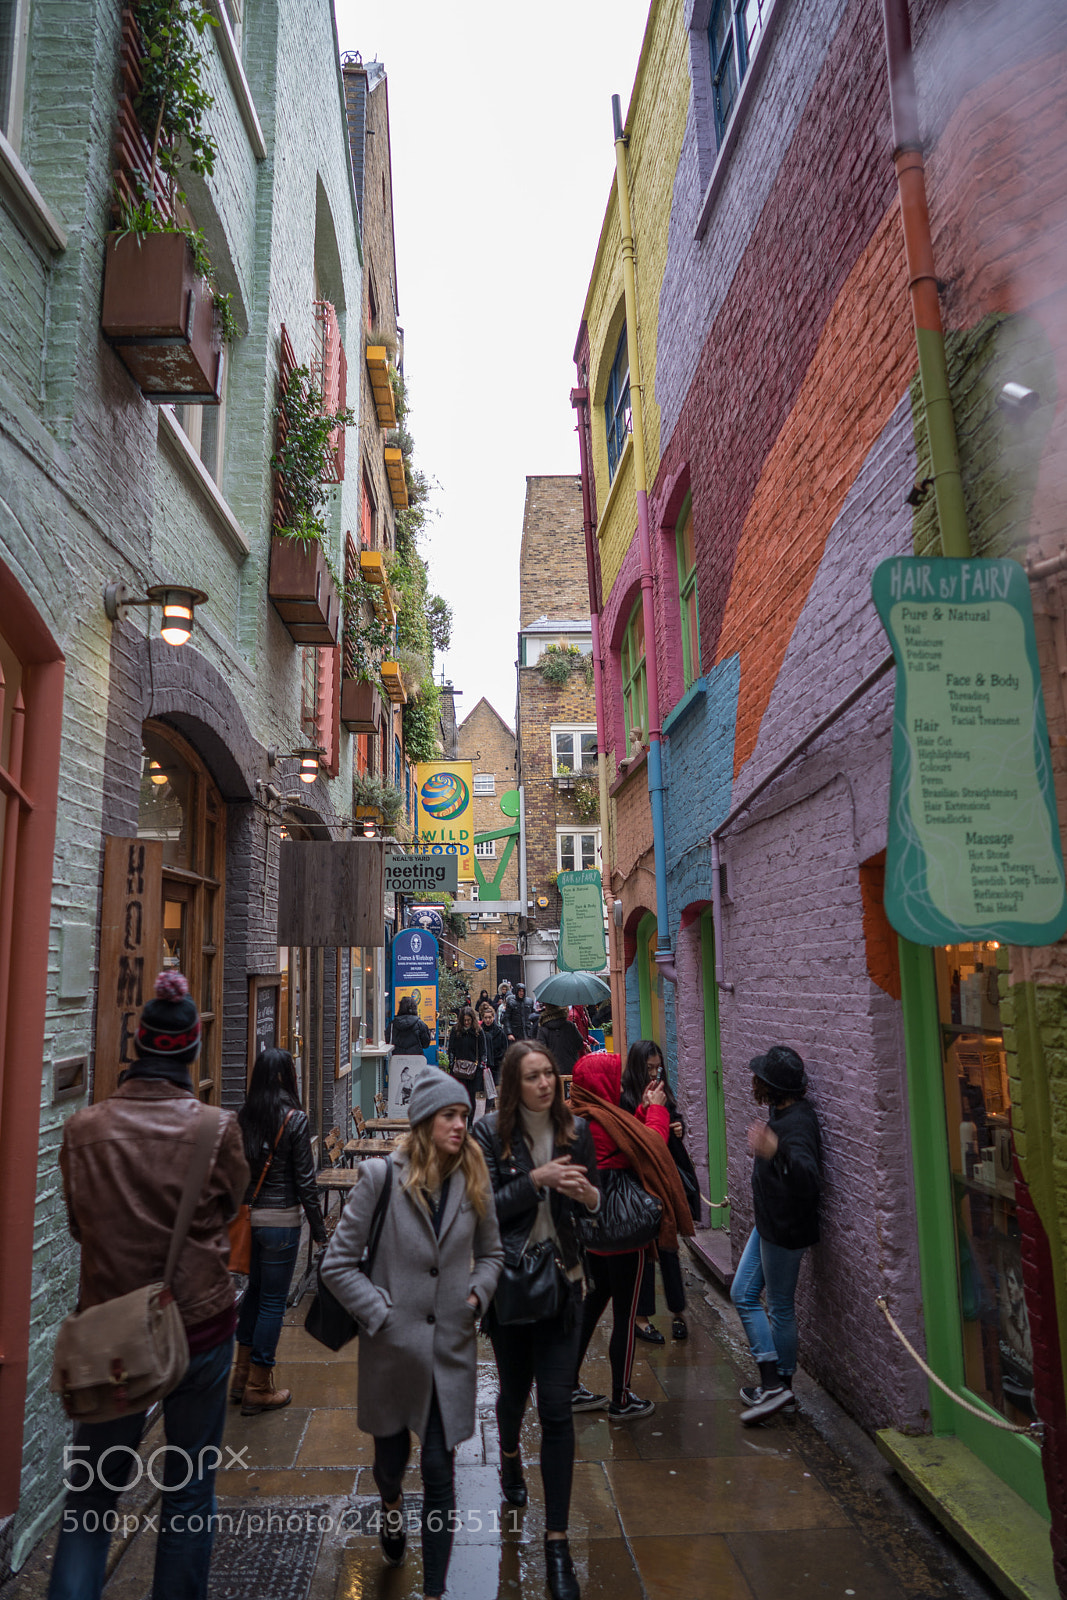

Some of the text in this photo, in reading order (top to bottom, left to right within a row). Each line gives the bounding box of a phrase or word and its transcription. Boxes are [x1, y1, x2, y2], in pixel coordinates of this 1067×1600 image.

[890, 560, 1014, 601] HAIR BY FAIRY
[901, 607, 991, 622] Pure & Natural
[904, 625, 921, 634] Nail
[905, 637, 943, 647] Manicure
[906, 649, 942, 659] Pedicure
[908, 661, 940, 672] Full Set
[946, 673, 1019, 691] Face & Body
[948, 690, 990, 703] Threading
[950, 702, 982, 715] Waxing
[914, 718, 939, 732] Hair
[951, 715, 1020, 726] Facial Treatment
[916, 736, 952, 746] Hair Cut
[918, 748, 970, 761] Highlighting
[919, 761, 952, 772] Colours
[921, 775, 944, 785] Perm
[922, 787, 1018, 800] Brazilian Straightening
[924, 800, 991, 811] Hair Extensions
[925, 814, 973, 824] Dreadlocks
[421, 829, 469, 841] WILD
[965, 832, 1014, 849] Massage
[968, 849, 1010, 860] Hot Stone
[970, 862, 1035, 875] Aroma Therapy
[386, 878, 436, 890] rooms
[972, 874, 1058, 888] Swedish Deep Tissue
[973, 889, 1024, 901] Reflexology
[975, 902, 1018, 913] Thai Head
[415, 954, 434, 962] Workshops
[117, 844, 145, 1088] HOME
